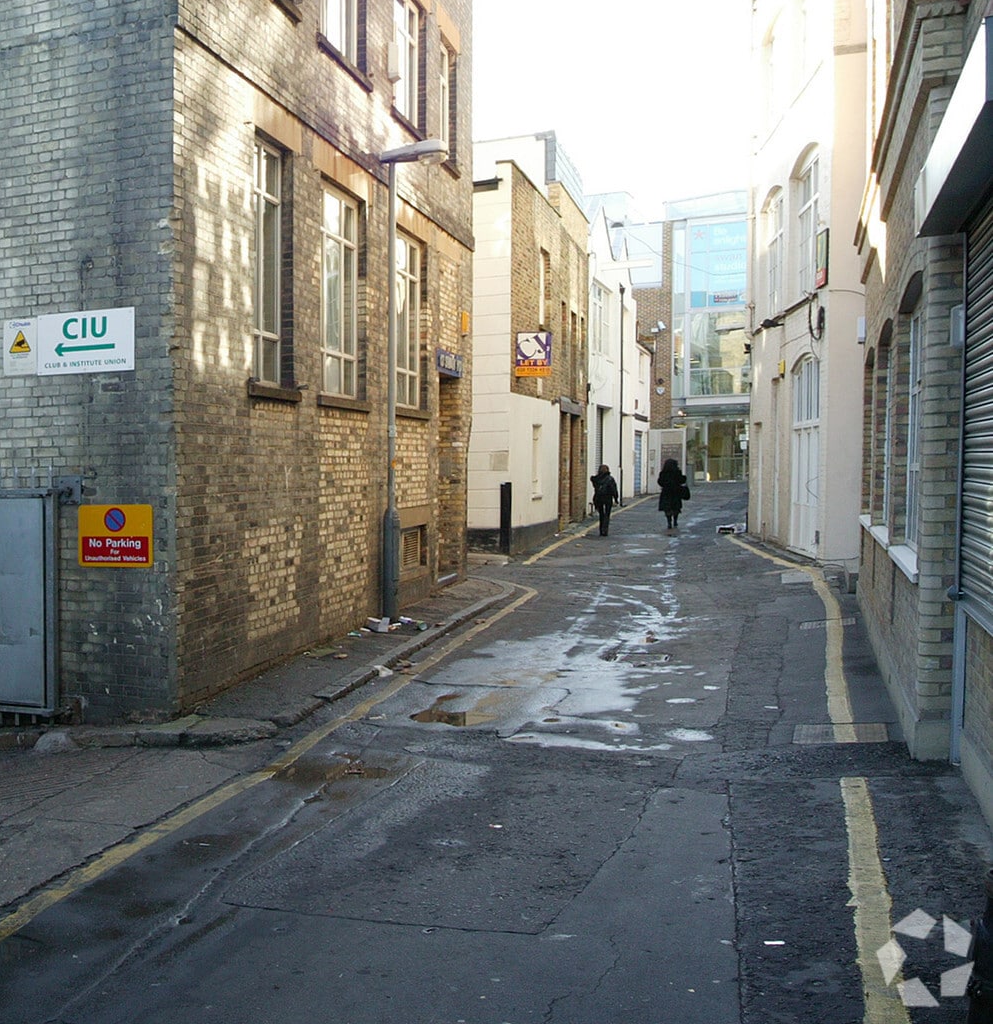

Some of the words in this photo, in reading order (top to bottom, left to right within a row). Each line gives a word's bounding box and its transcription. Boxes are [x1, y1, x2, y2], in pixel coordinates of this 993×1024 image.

[62, 316, 107, 340] CIU
[89, 538, 102, 547] No
[106, 538, 141, 549] Parking
